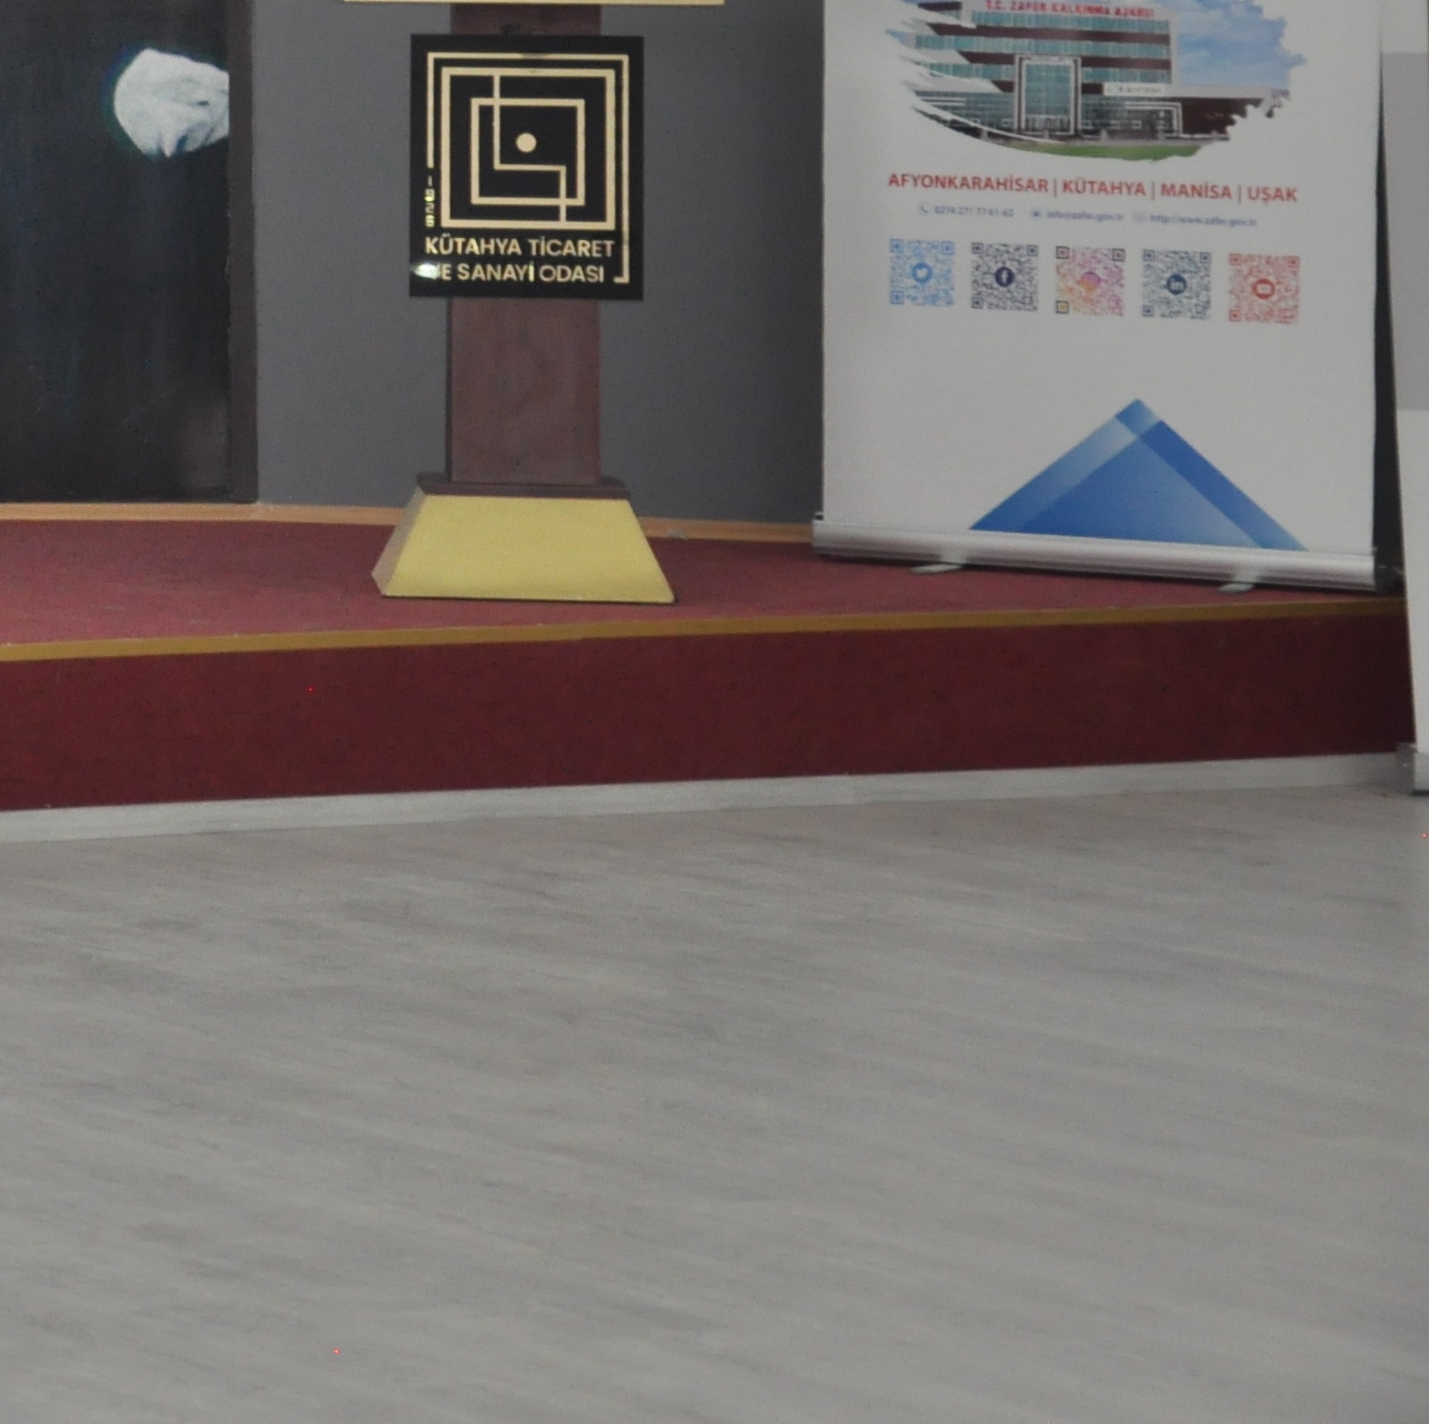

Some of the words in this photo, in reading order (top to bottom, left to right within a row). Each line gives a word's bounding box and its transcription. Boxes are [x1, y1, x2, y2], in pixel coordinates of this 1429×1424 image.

[888, 173, 1049, 194] AFYONKARAHİSAR
[1063, 177, 1146, 197] KÜTAHYA
[1161, 182, 1233, 201] MANİSA
[1247, 186, 1298, 206] UŞAK
[425, 232, 522, 257] KÜTAHYA
[528, 235, 615, 257] TİCARET
[457, 261, 534, 282] SANAYİ
[539, 265, 604, 283] ODASI
